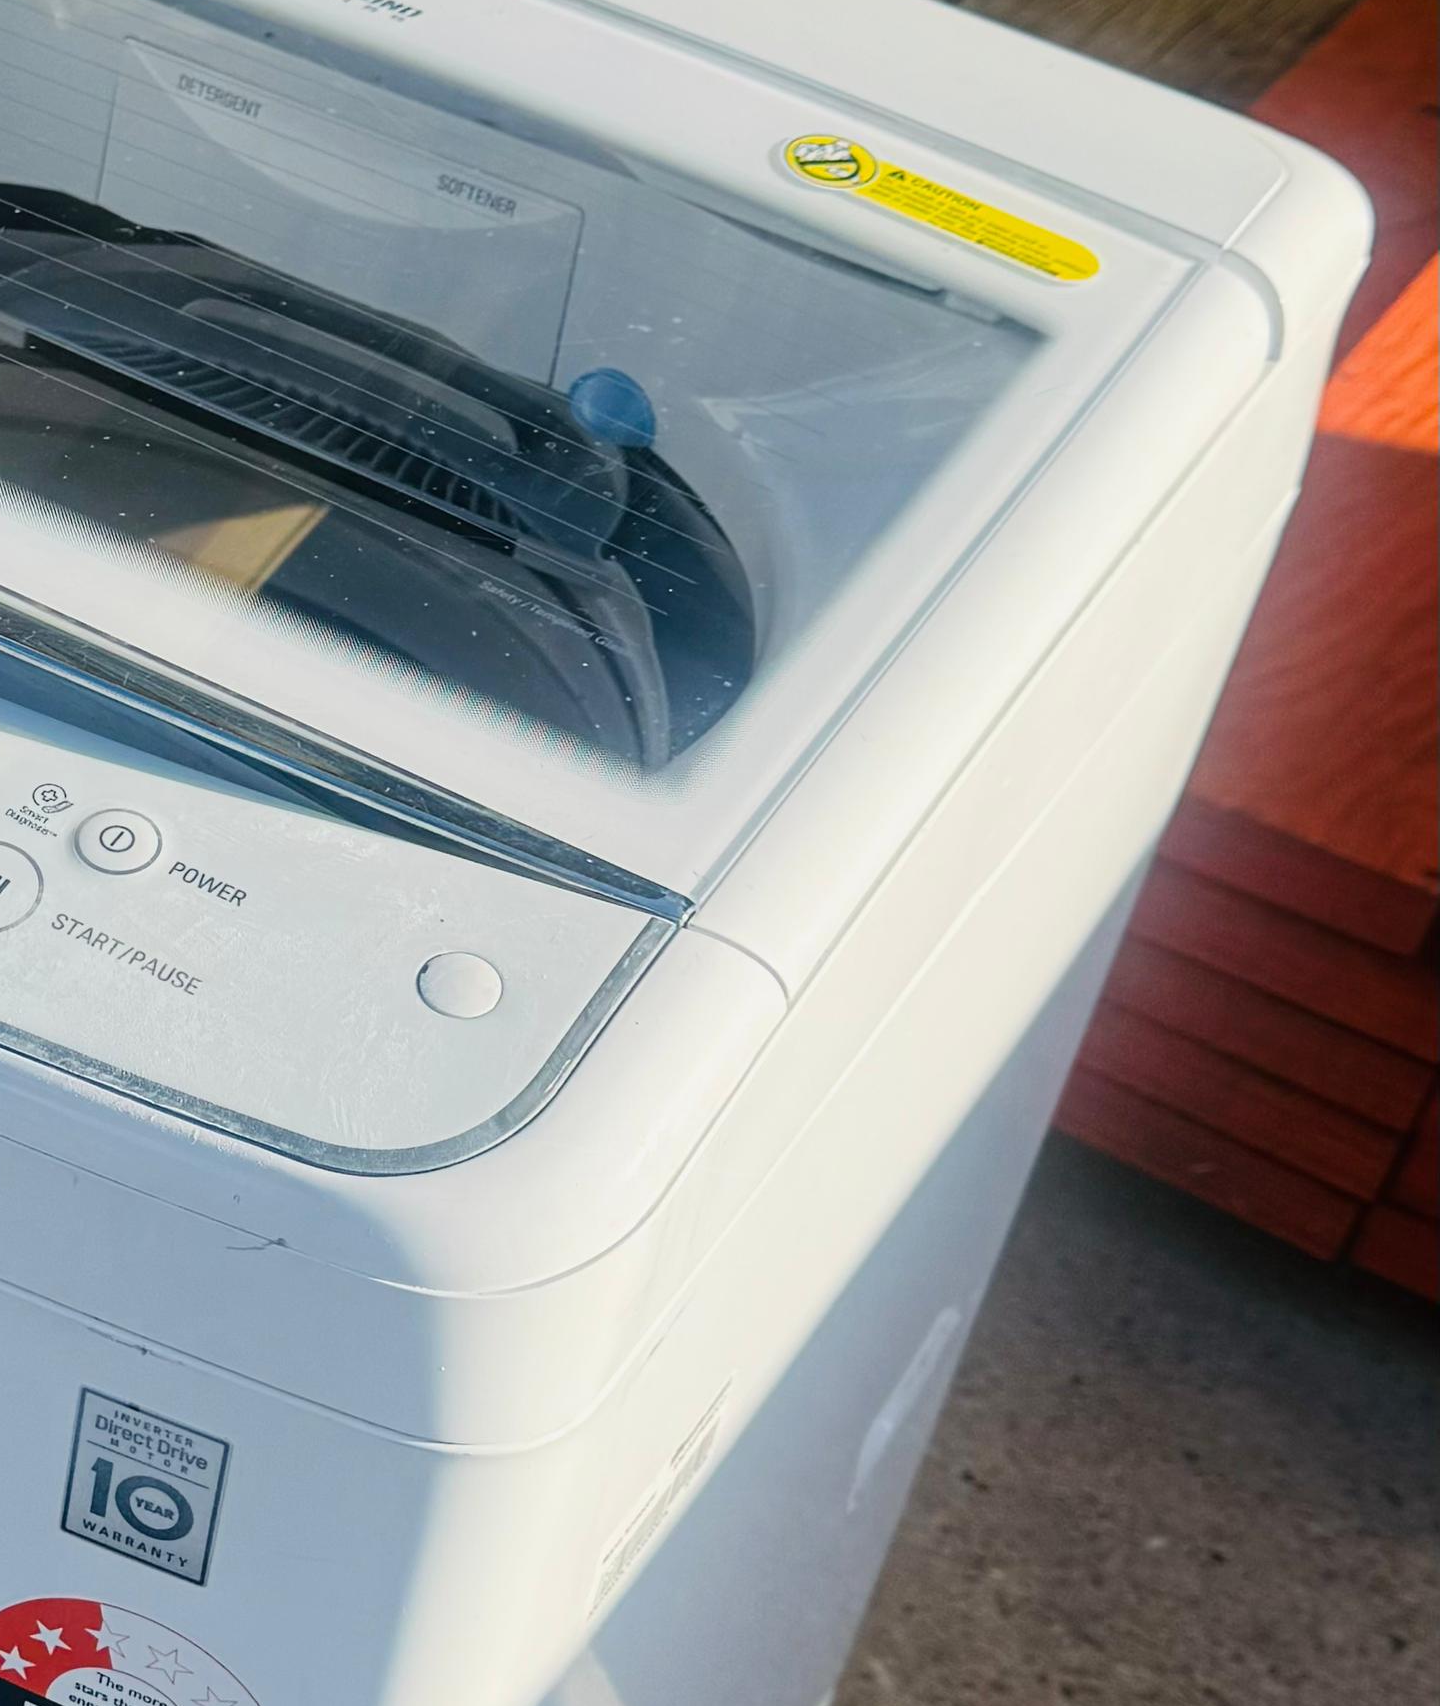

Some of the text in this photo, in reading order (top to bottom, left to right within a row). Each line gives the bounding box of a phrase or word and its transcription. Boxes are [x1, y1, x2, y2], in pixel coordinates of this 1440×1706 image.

[177, 73, 262, 118] DETERGENT
[437, 173, 517, 217] SOFTENER
[909, 177, 981, 212] CAUTION
[168, 861, 248, 907] POWER
[51, 913, 203, 996] START/PAUSE
[95, 1414, 209, 1470] Direct Drive
[114, 1410, 194, 1448] INVERTER
[110, 1437, 189, 1475] MOTOR
[89, 1456, 194, 1541] 10
[135, 1496, 175, 1521] YEAR
[82, 1518, 189, 1568] WARRANTY
[75, 1682, 109, 1702] stars
[97, 1671, 124, 1692] The
